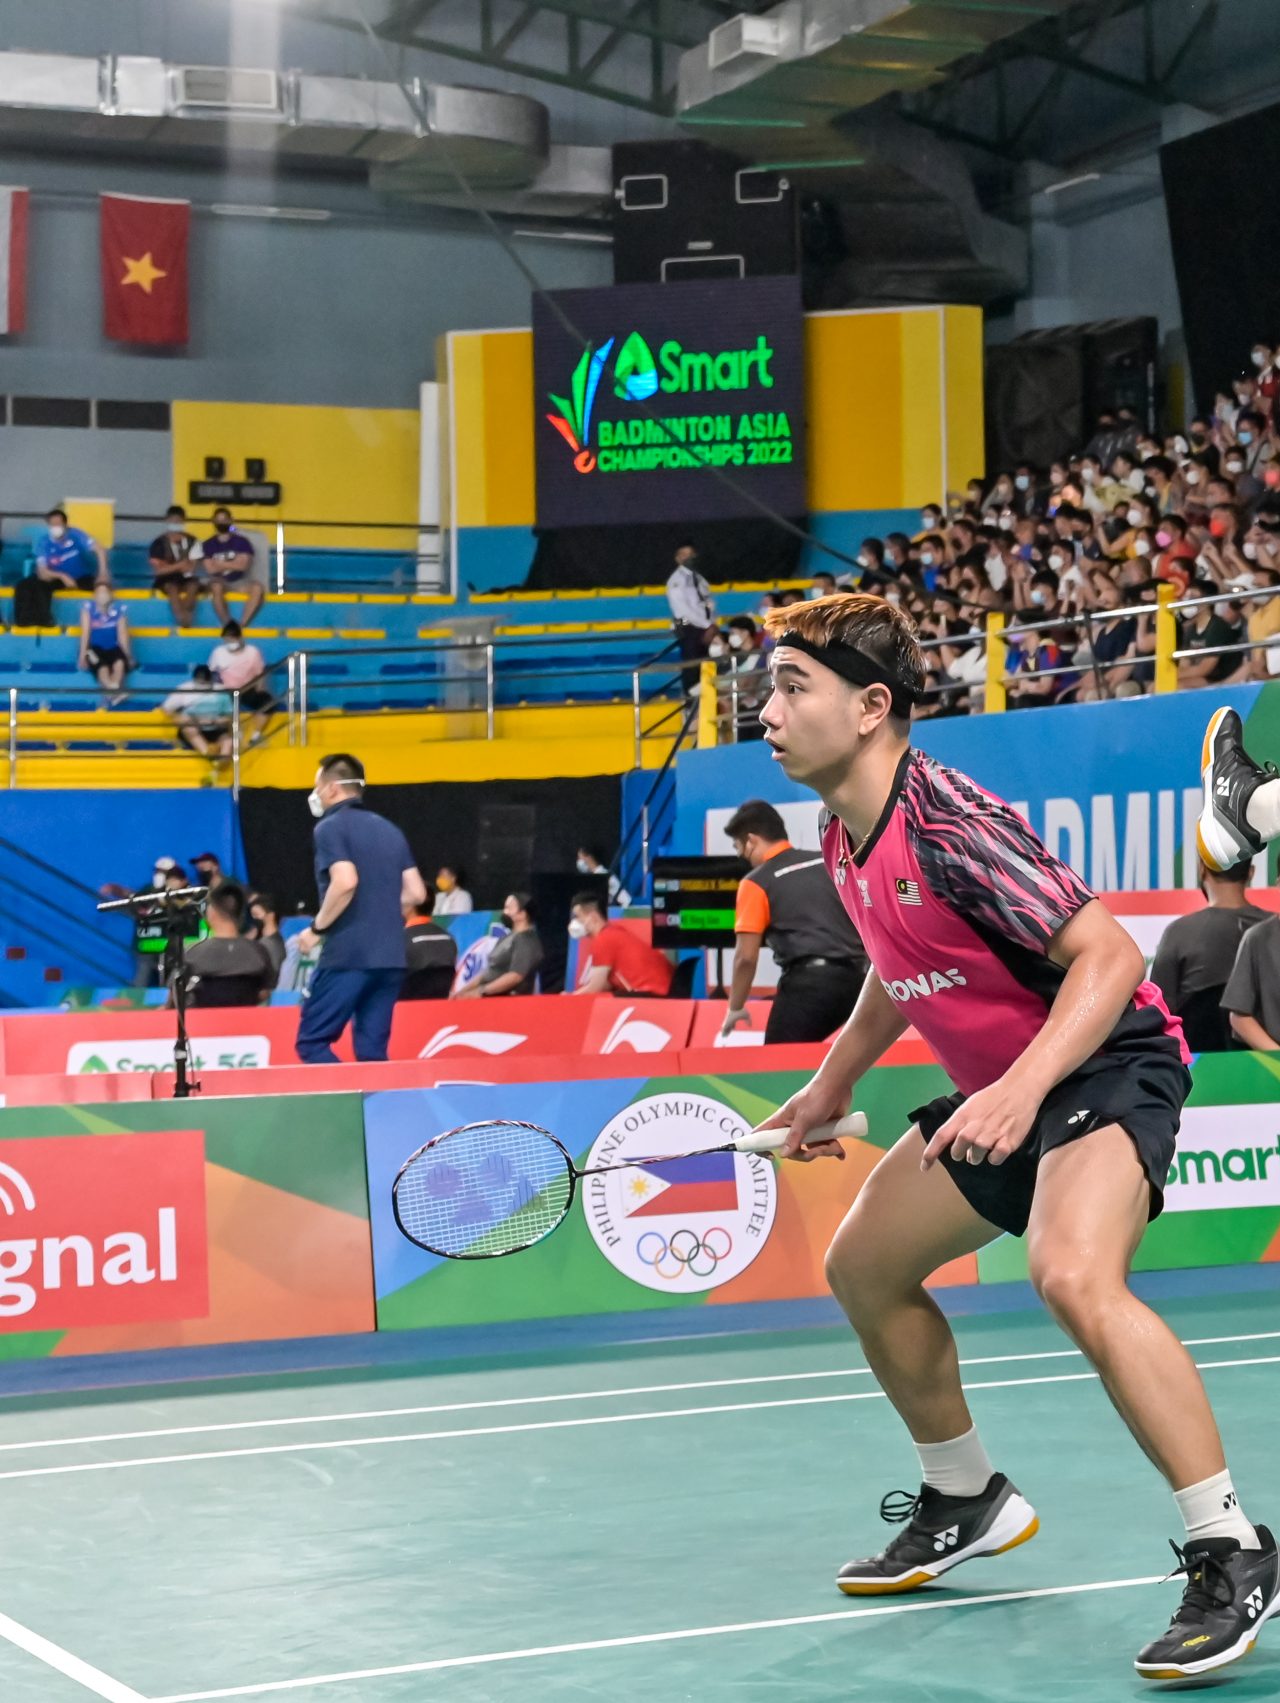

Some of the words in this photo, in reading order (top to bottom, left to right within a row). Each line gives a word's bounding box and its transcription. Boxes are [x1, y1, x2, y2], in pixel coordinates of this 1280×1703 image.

[659, 336, 774, 394] Smart
[736, 411, 792, 441] ASIA
[746, 440, 793, 466] 2022
[881, 968, 967, 1002] RONAS
[591, 1129, 626, 1248] PHILIPPINE
[623, 1100, 717, 1132] OLYMPIC
[718, 1116, 770, 1239] COMITTEE
[0, 1206, 178, 1317] gnal
